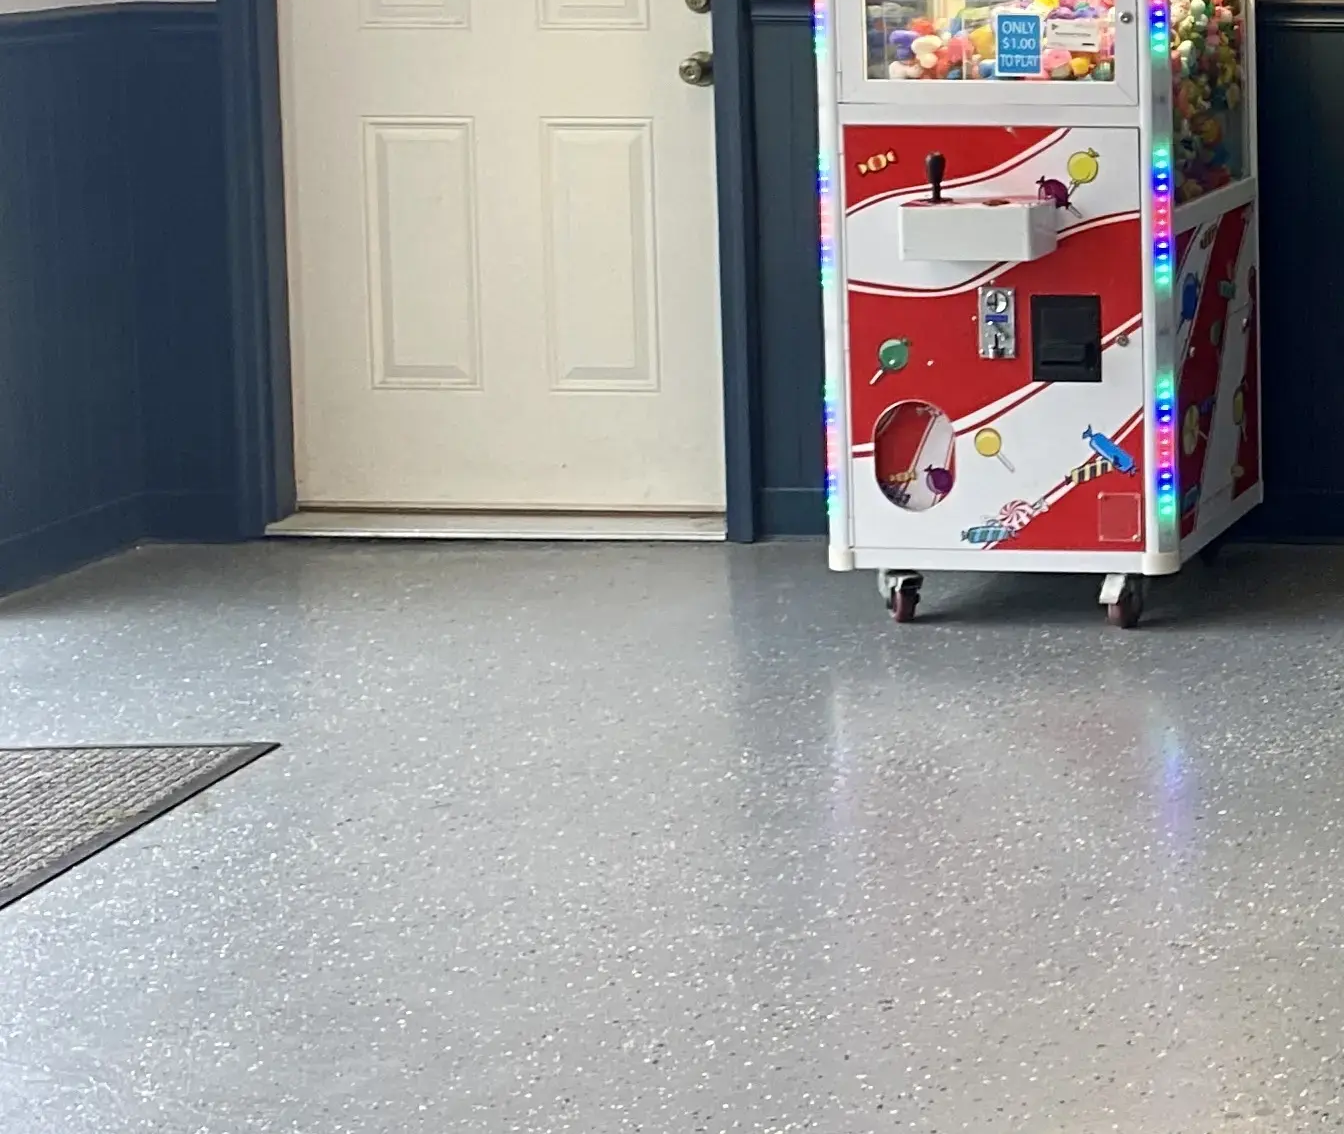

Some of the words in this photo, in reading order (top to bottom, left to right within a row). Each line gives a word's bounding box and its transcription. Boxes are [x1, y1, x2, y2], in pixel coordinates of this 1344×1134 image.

[1002, 21, 1037, 34] ONLY
[1003, 37, 1037, 50] $1.00
[1000, 54, 1013, 67] TO
[1015, 54, 1038, 67] PLAY
